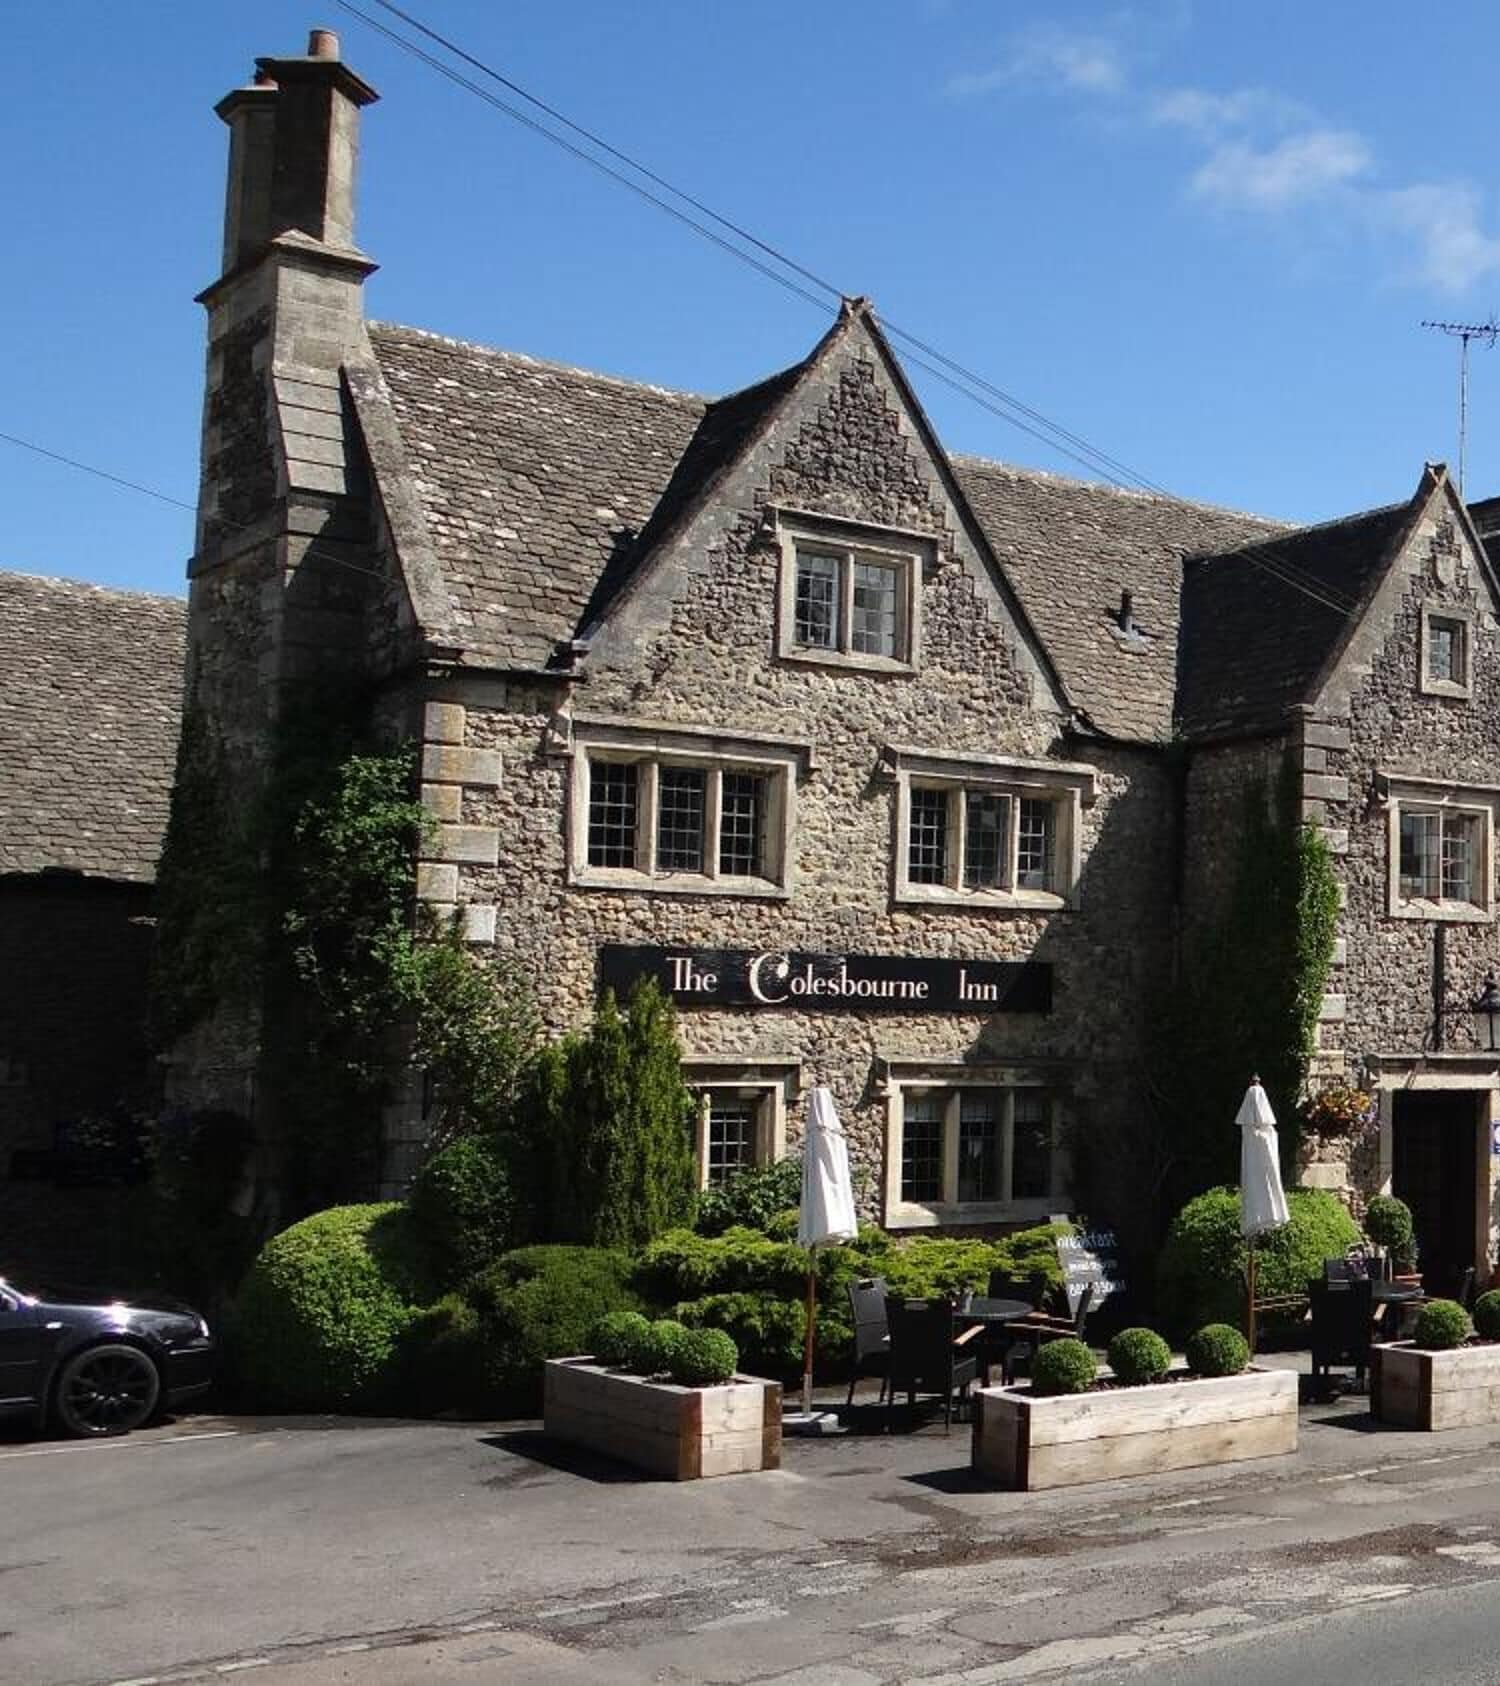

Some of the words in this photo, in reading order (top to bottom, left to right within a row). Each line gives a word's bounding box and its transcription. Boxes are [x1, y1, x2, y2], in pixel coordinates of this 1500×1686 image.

[665, 957, 718, 993] The
[745, 952, 930, 1003] Colesbourne
[958, 969, 998, 1001] Inn
